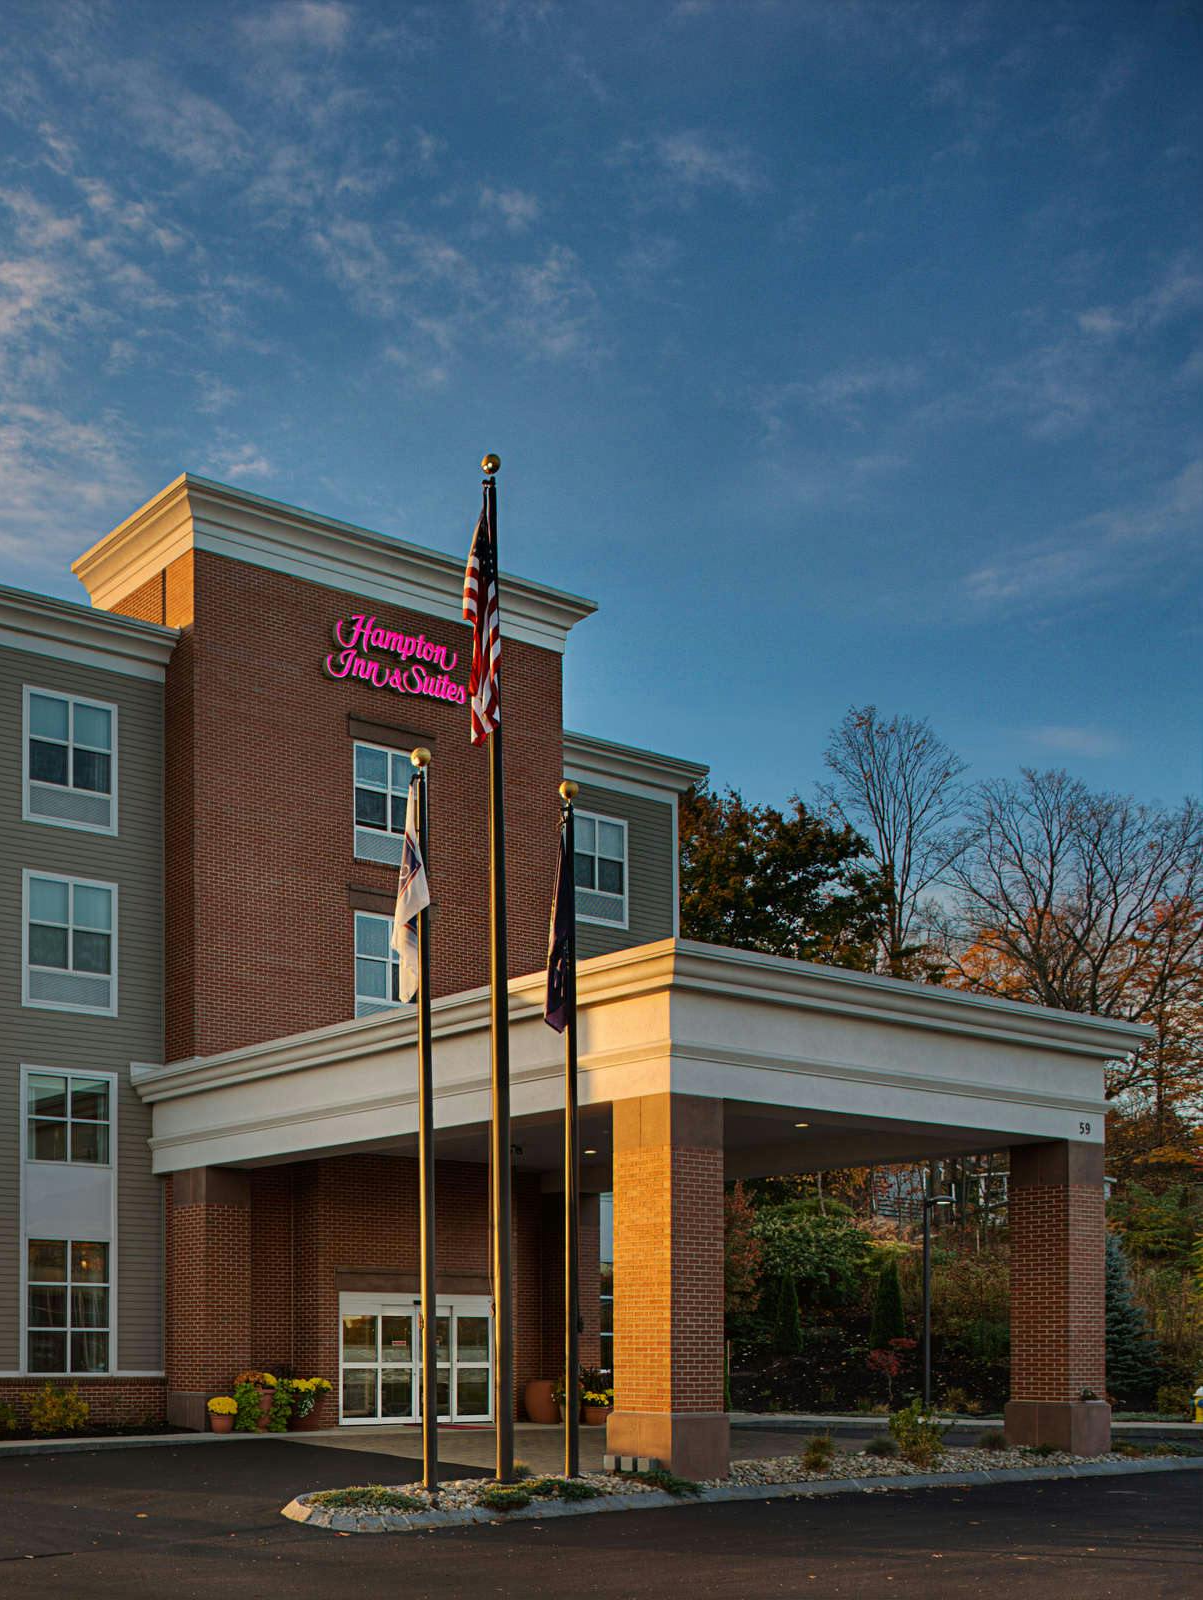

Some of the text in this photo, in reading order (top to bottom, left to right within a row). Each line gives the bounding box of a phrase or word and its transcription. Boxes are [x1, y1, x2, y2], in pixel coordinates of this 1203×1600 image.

[336, 614, 459, 671] Hampton
[327, 649, 390, 687] Inn
[404, 664, 466, 704] Suites
[1079, 1121, 1091, 1136] 59
